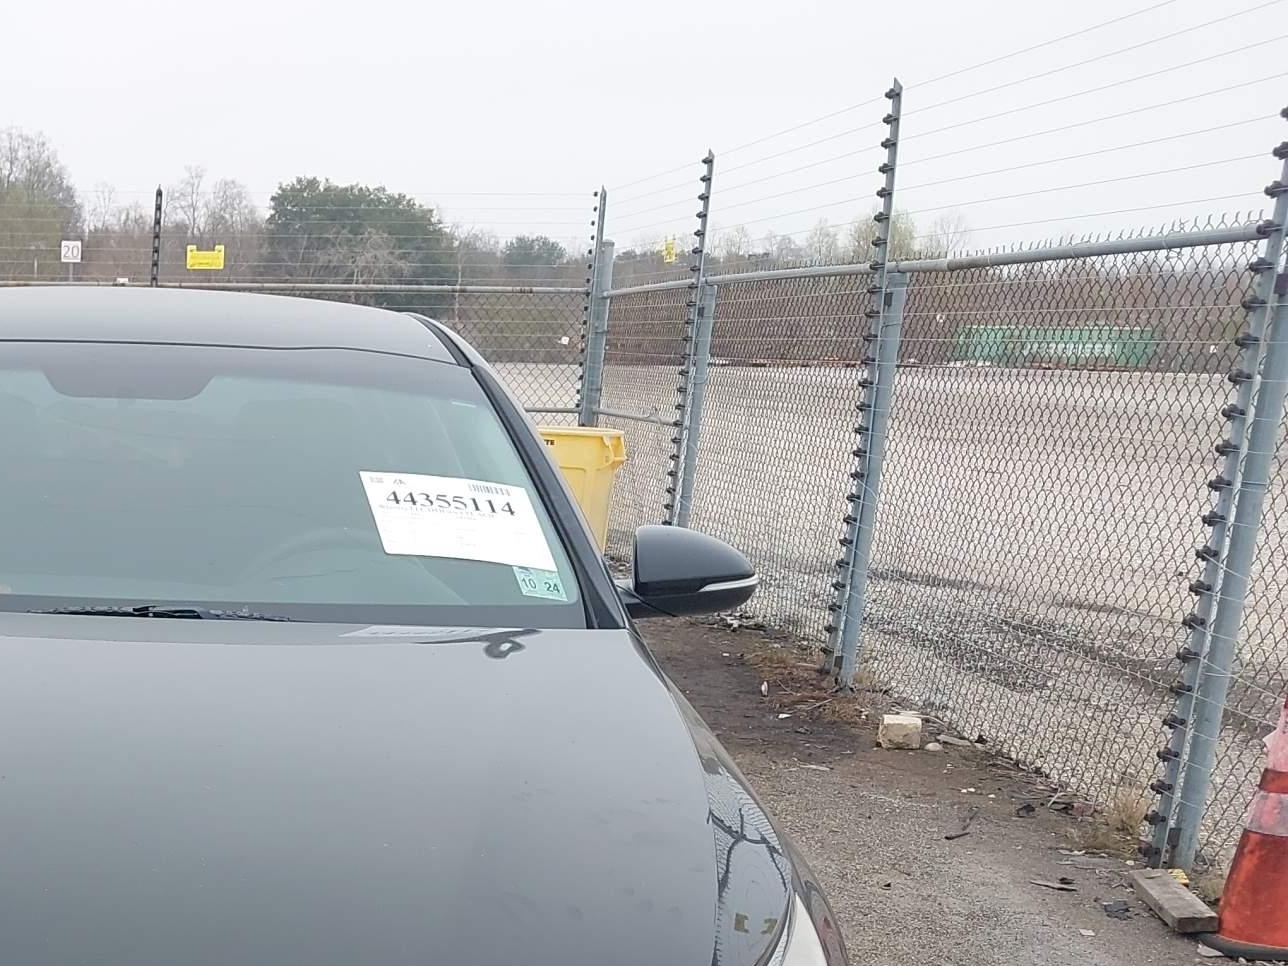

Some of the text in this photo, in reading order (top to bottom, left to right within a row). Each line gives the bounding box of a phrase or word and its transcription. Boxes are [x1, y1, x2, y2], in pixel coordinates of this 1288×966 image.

[386, 490, 516, 516] 44355114
[522, 578, 560, 593] 10 24
